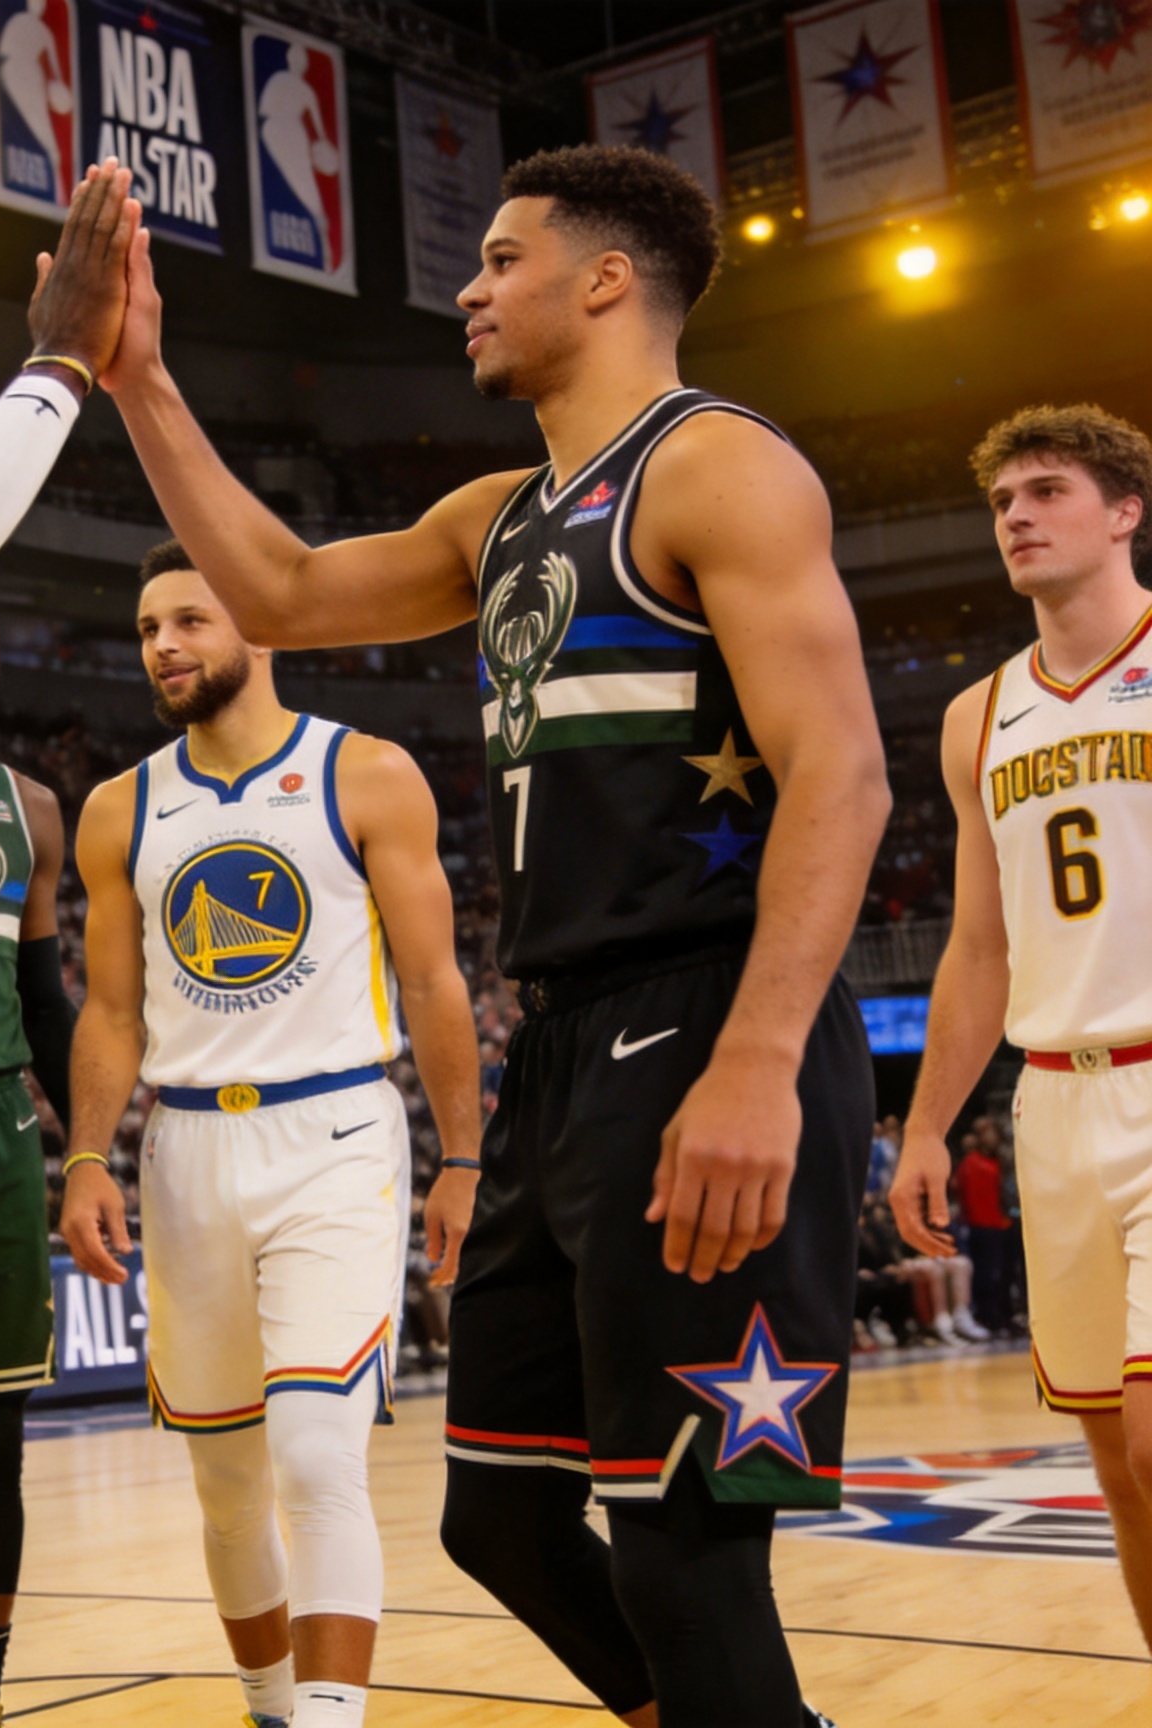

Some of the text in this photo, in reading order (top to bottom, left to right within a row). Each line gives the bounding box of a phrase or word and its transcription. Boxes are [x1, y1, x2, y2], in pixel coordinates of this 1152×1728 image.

[98, 23, 202, 143] NBA
[502, 765, 532, 872] 7
[1044, 805, 1105, 923] 6
[248, 870, 275, 911] 7
